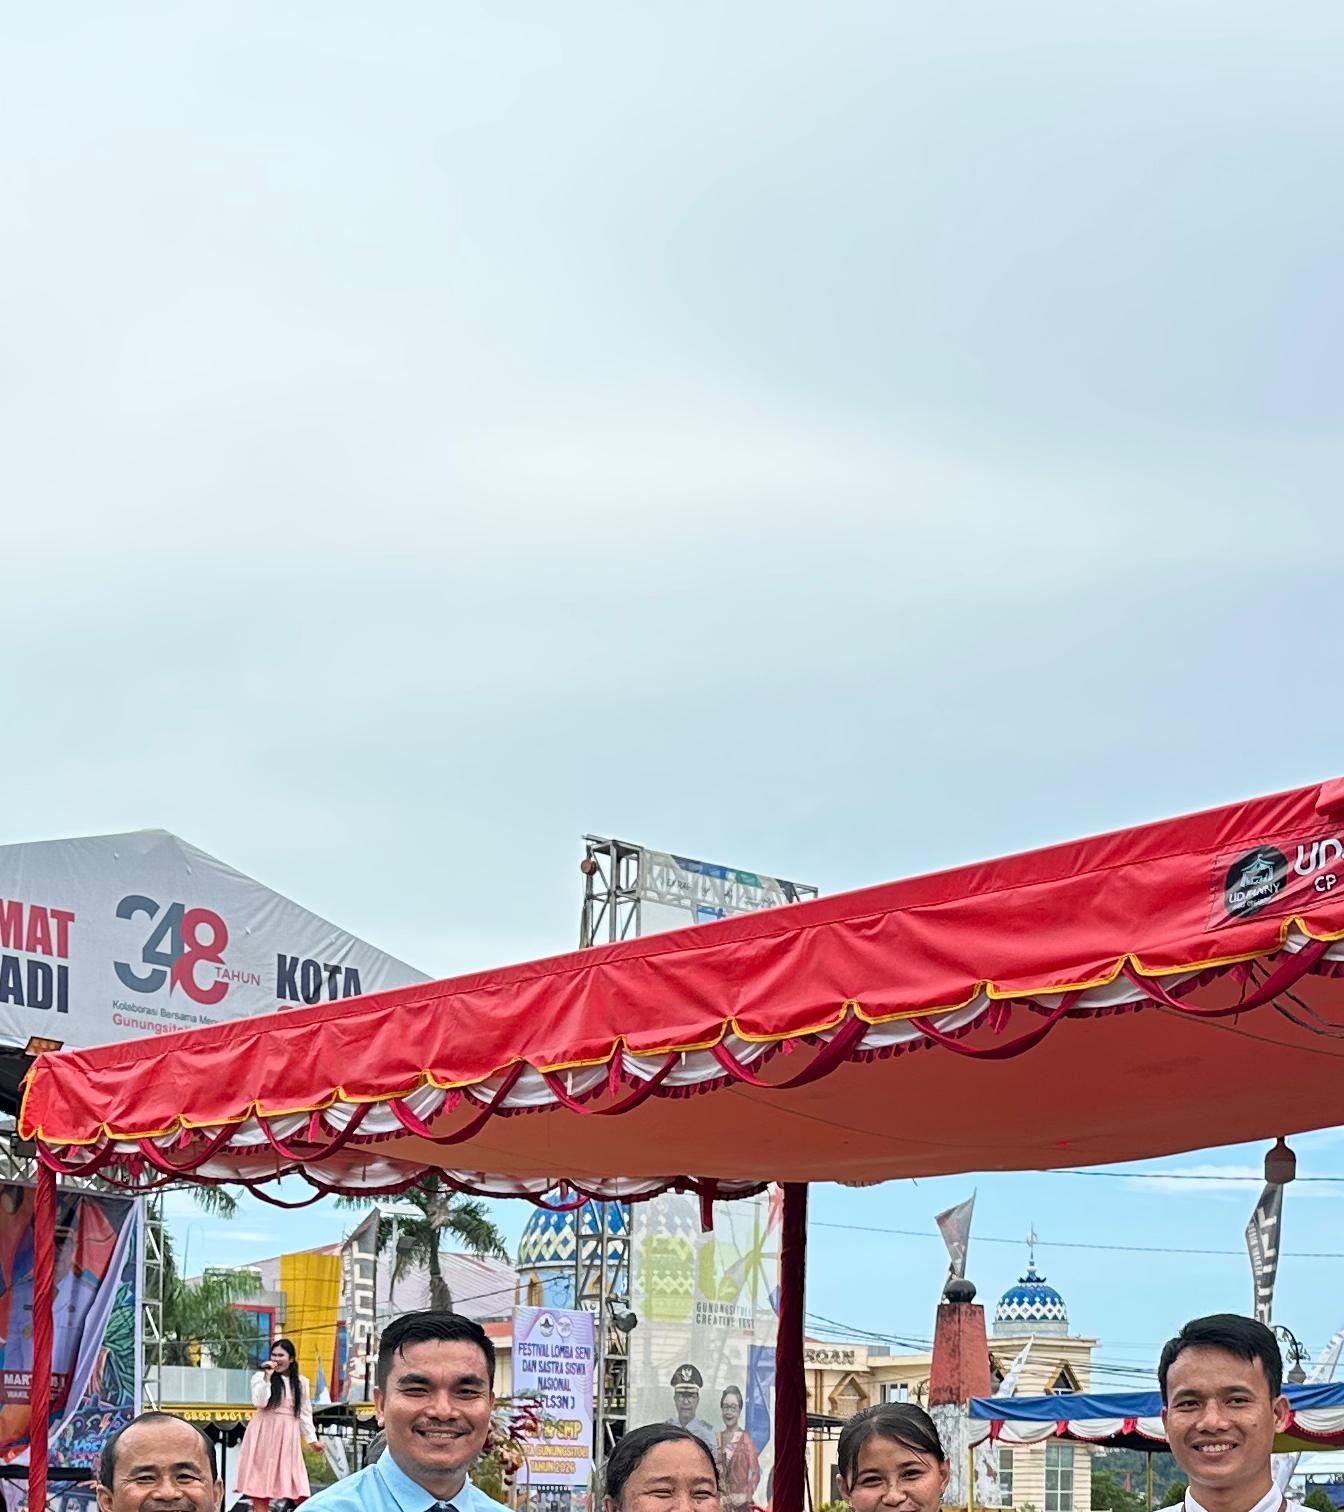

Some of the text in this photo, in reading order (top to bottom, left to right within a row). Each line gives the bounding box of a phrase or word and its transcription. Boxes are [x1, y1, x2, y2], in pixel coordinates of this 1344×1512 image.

[1314, 873, 1336, 892] CP
[215, 967, 260, 986] TAHUN
[276, 953, 362, 1005] KOTA
[112, 1000, 158, 1016] Kolaborasi
[160, 1008, 197, 1023] Bersama
[518, 1343, 591, 1360] FESTIVAL LOMBA SENI
[522, 1360, 586, 1376] DAN SASTRA SISWA
[538, 1376, 571, 1392] NASIONAL
